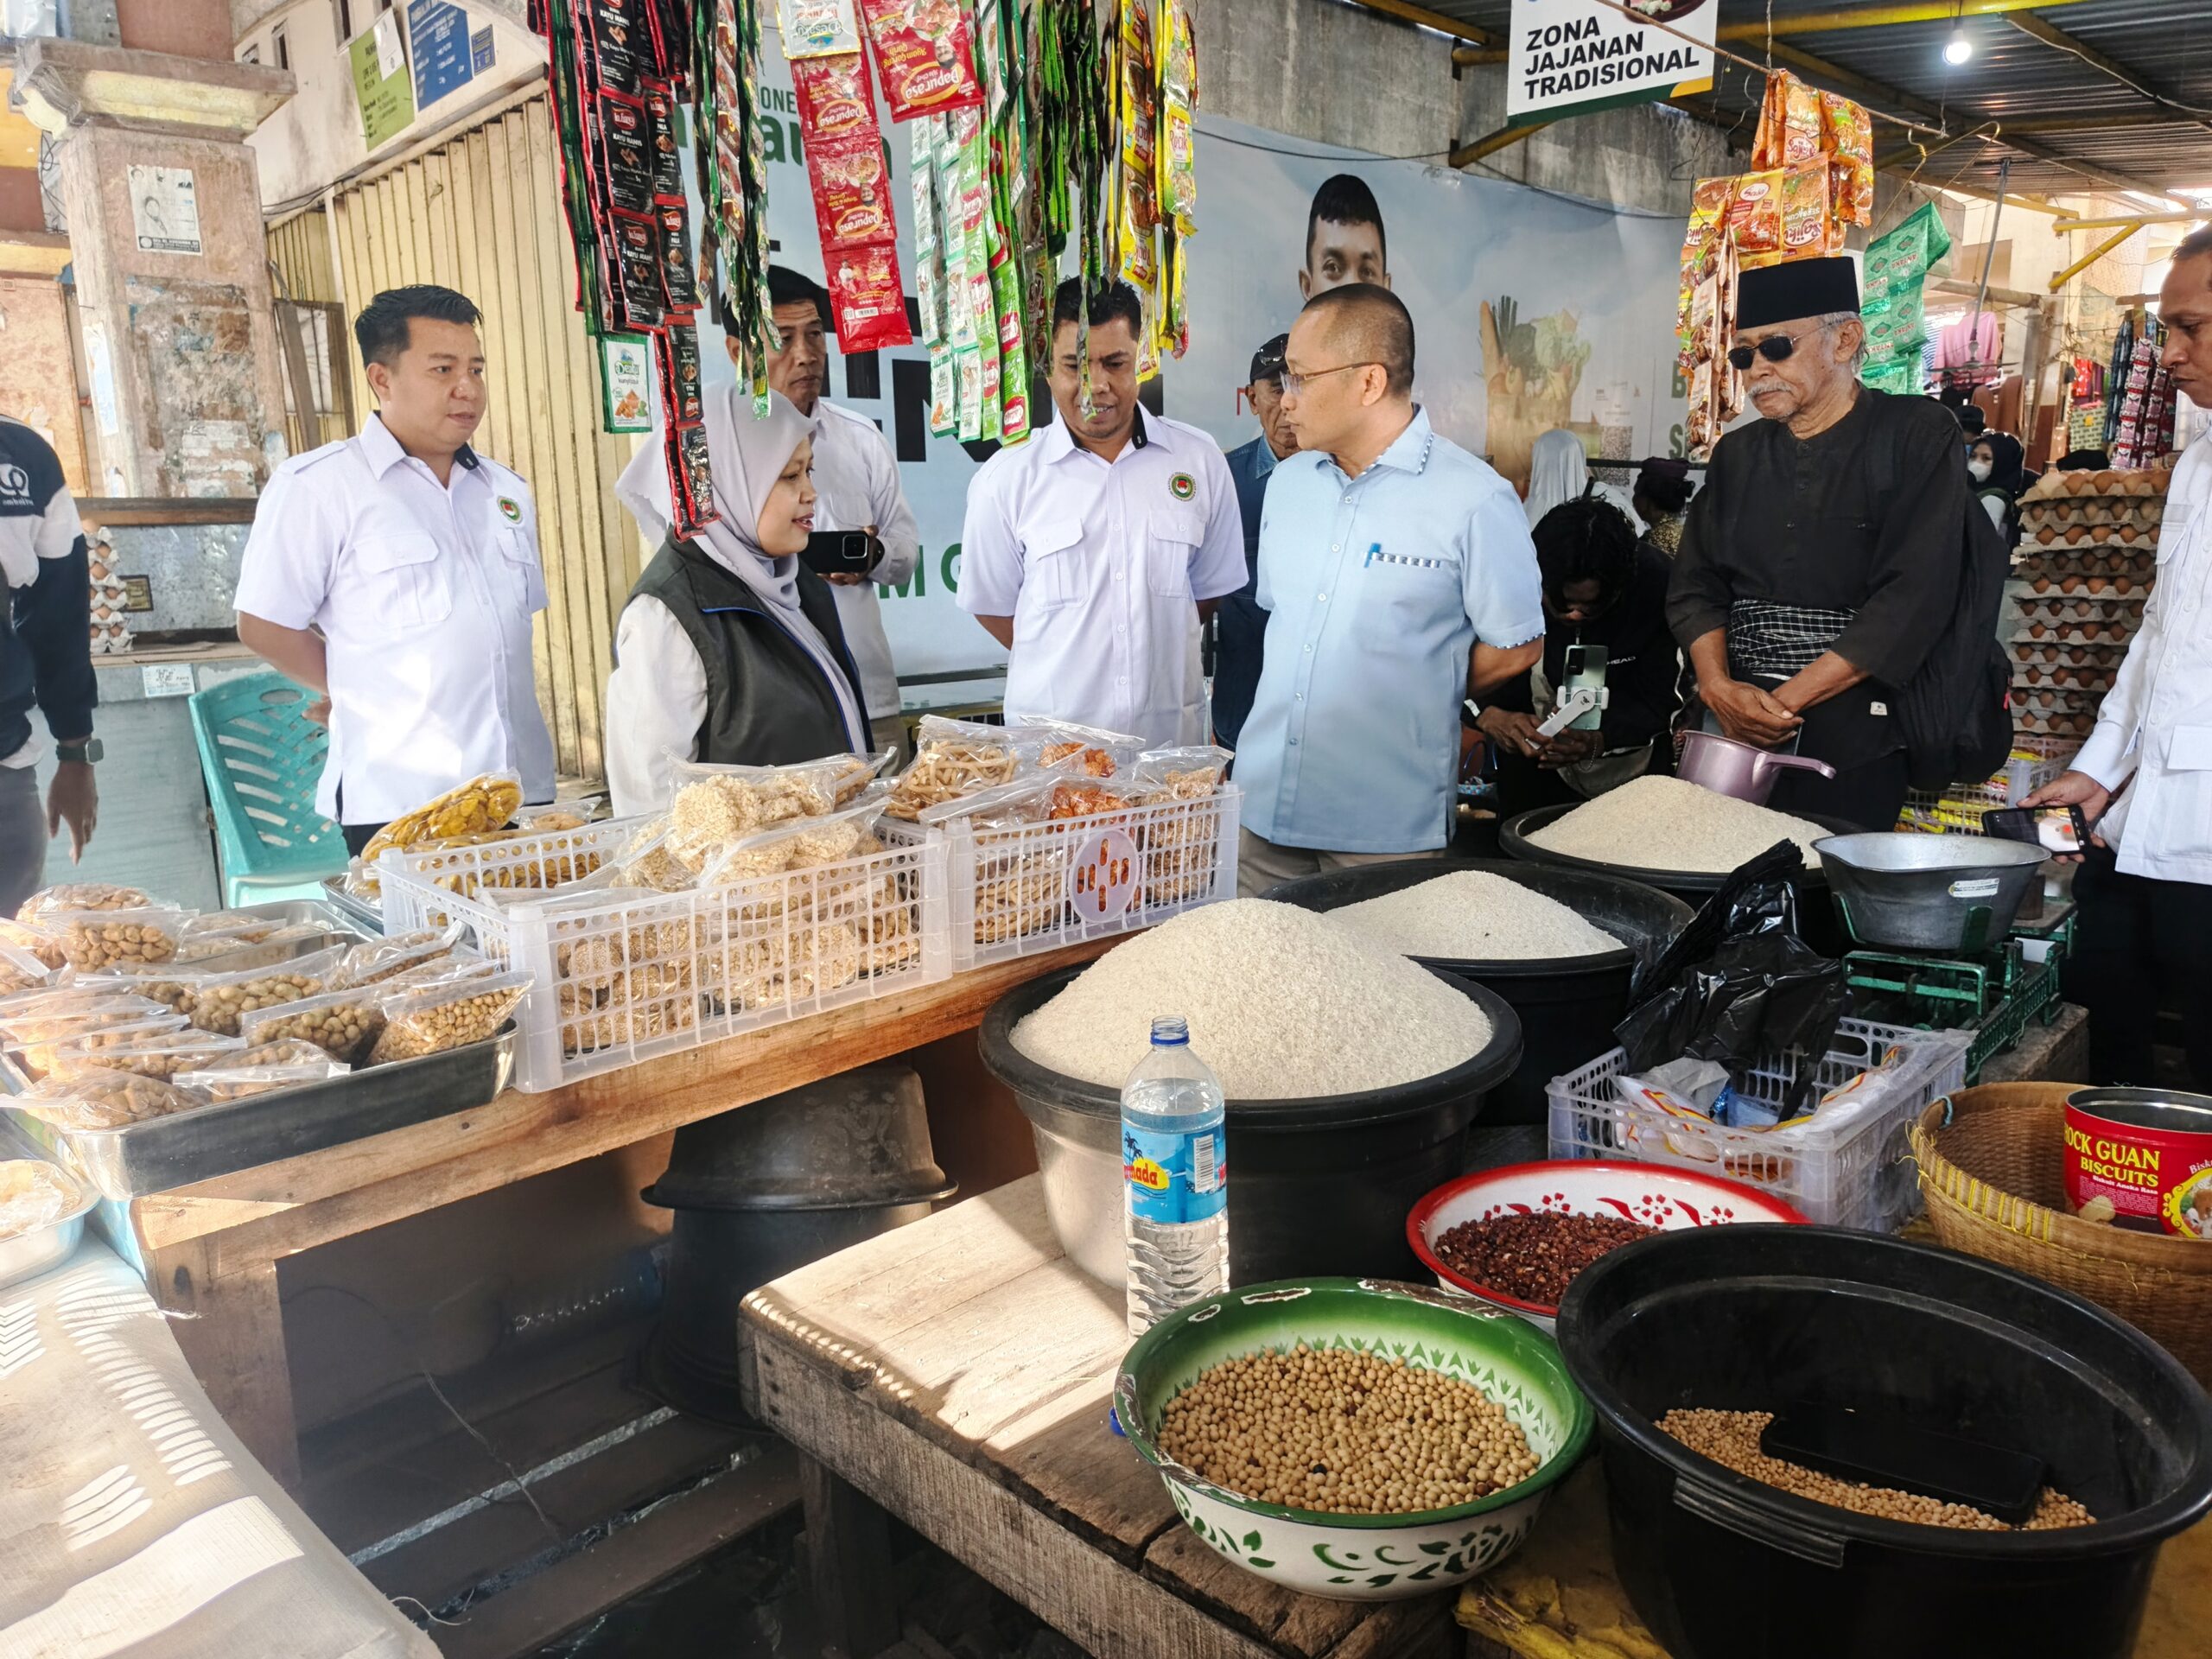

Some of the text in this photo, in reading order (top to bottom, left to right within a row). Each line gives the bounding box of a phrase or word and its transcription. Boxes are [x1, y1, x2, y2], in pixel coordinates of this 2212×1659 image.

[1526, 16, 1601, 52] ZONA
[1524, 30, 1644, 76] JAJANAN
[905, 69, 960, 100] Dapurasa
[1524, 46, 1700, 100] TRADISIONAL
[820, 105, 862, 126] Dapurasa
[838, 212, 880, 233] Dapurasa
[2080, 1156, 2158, 1187] BISCUITS
[2095, 1141, 2160, 1171] GUAN
[2092, 1174, 2115, 1186] Biskuit
[2116, 1181, 2139, 1192] Aneka
